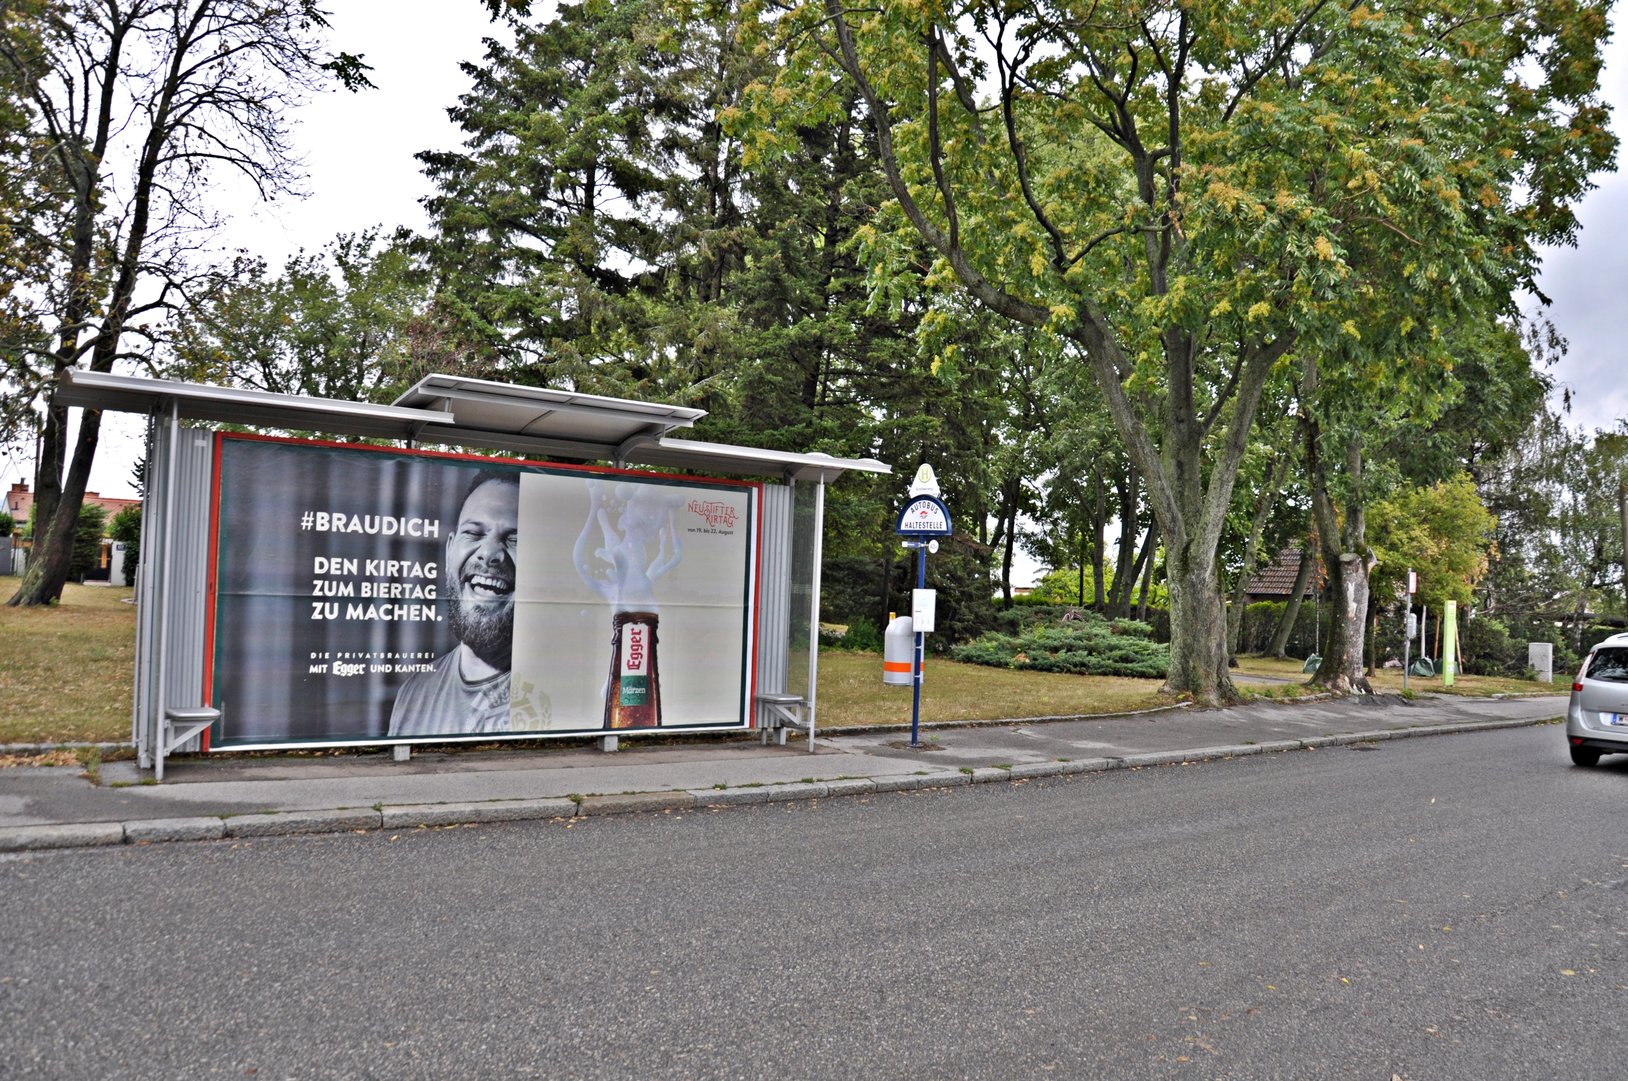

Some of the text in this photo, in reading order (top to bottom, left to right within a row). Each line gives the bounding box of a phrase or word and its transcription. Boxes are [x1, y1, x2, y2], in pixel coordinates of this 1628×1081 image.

[921, 467, 929, 480] H
[688, 500, 739, 519] NEUSTIFTER
[910, 501, 939, 514] AUTOBUS
[301, 511, 439, 538] #BRAUDICH
[706, 514, 734, 528] KIRTAG
[904, 521, 943, 529] HALTESTELLE
[314, 556, 437, 579] DEN KIRTAG
[312, 580, 437, 600] ZUM BIERTAG
[311, 602, 443, 622] ZU MACHEN.
[310, 652, 435, 660] DIE PRIVATBRAUEREI
[626, 627, 644, 671] Egger
[309, 661, 437, 677] MIT Egger UND KANTEN.
[622, 686, 646, 695] Märzen
